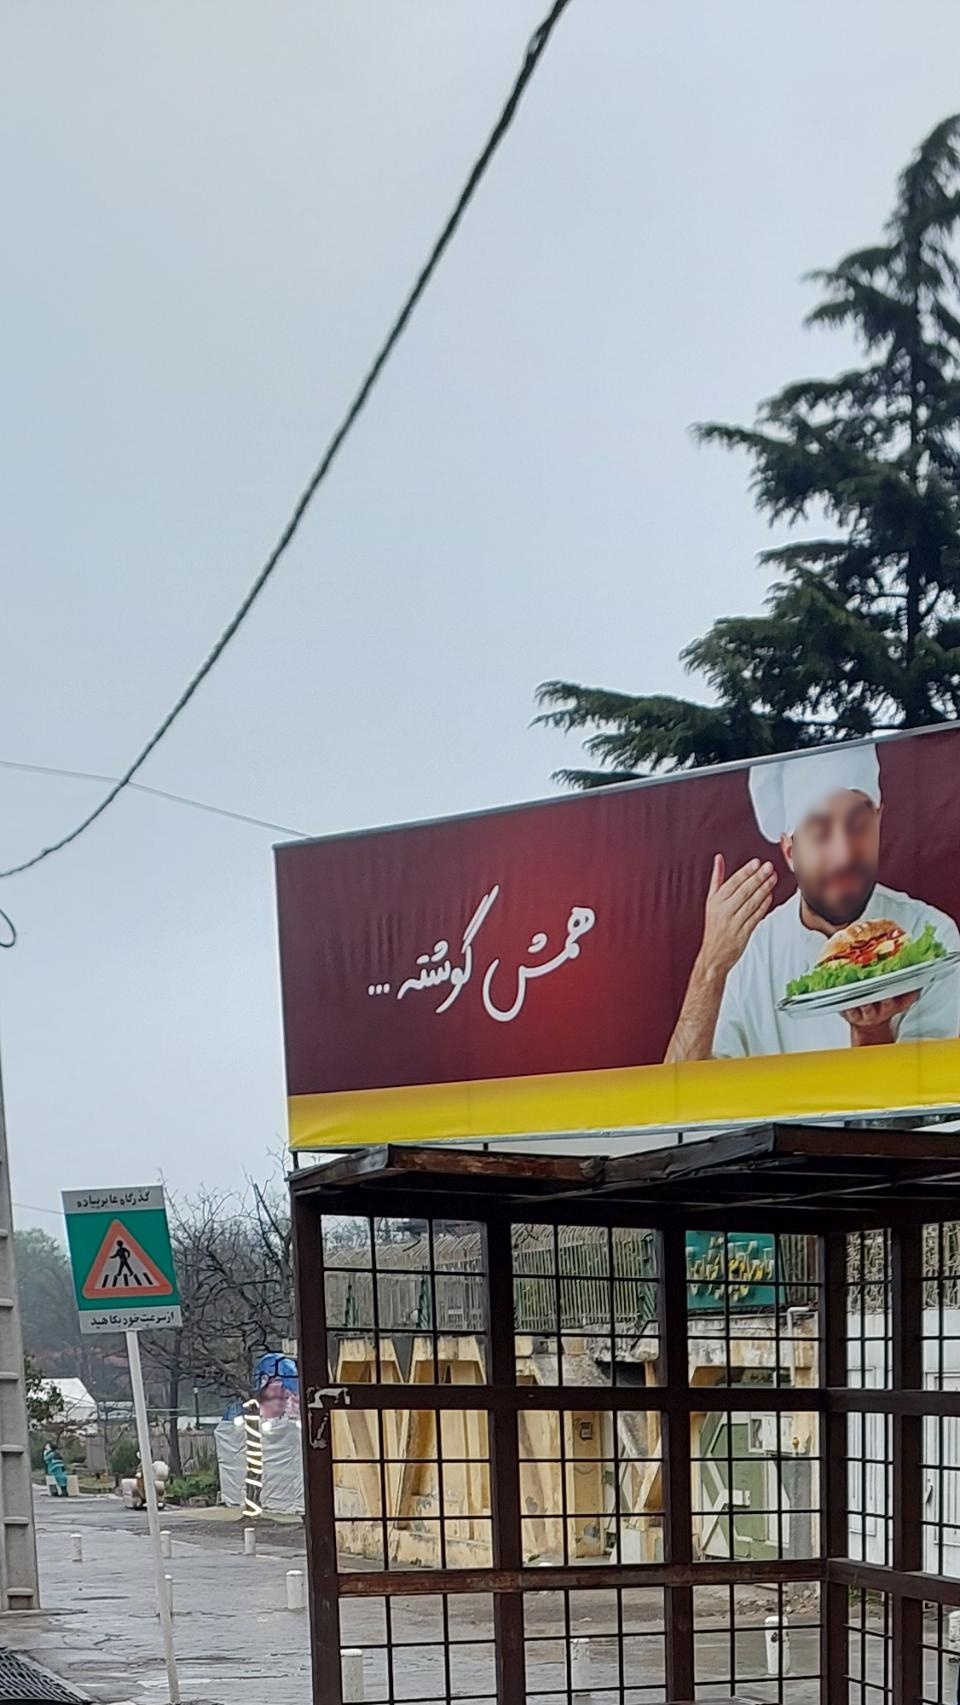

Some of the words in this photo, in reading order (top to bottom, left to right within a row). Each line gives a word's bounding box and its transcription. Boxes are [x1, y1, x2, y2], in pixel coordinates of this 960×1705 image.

[397, 884, 500, 1014] گوشته
[482, 906, 597, 1022] همش
[120, 1190, 150, 1206] گذرگاه
